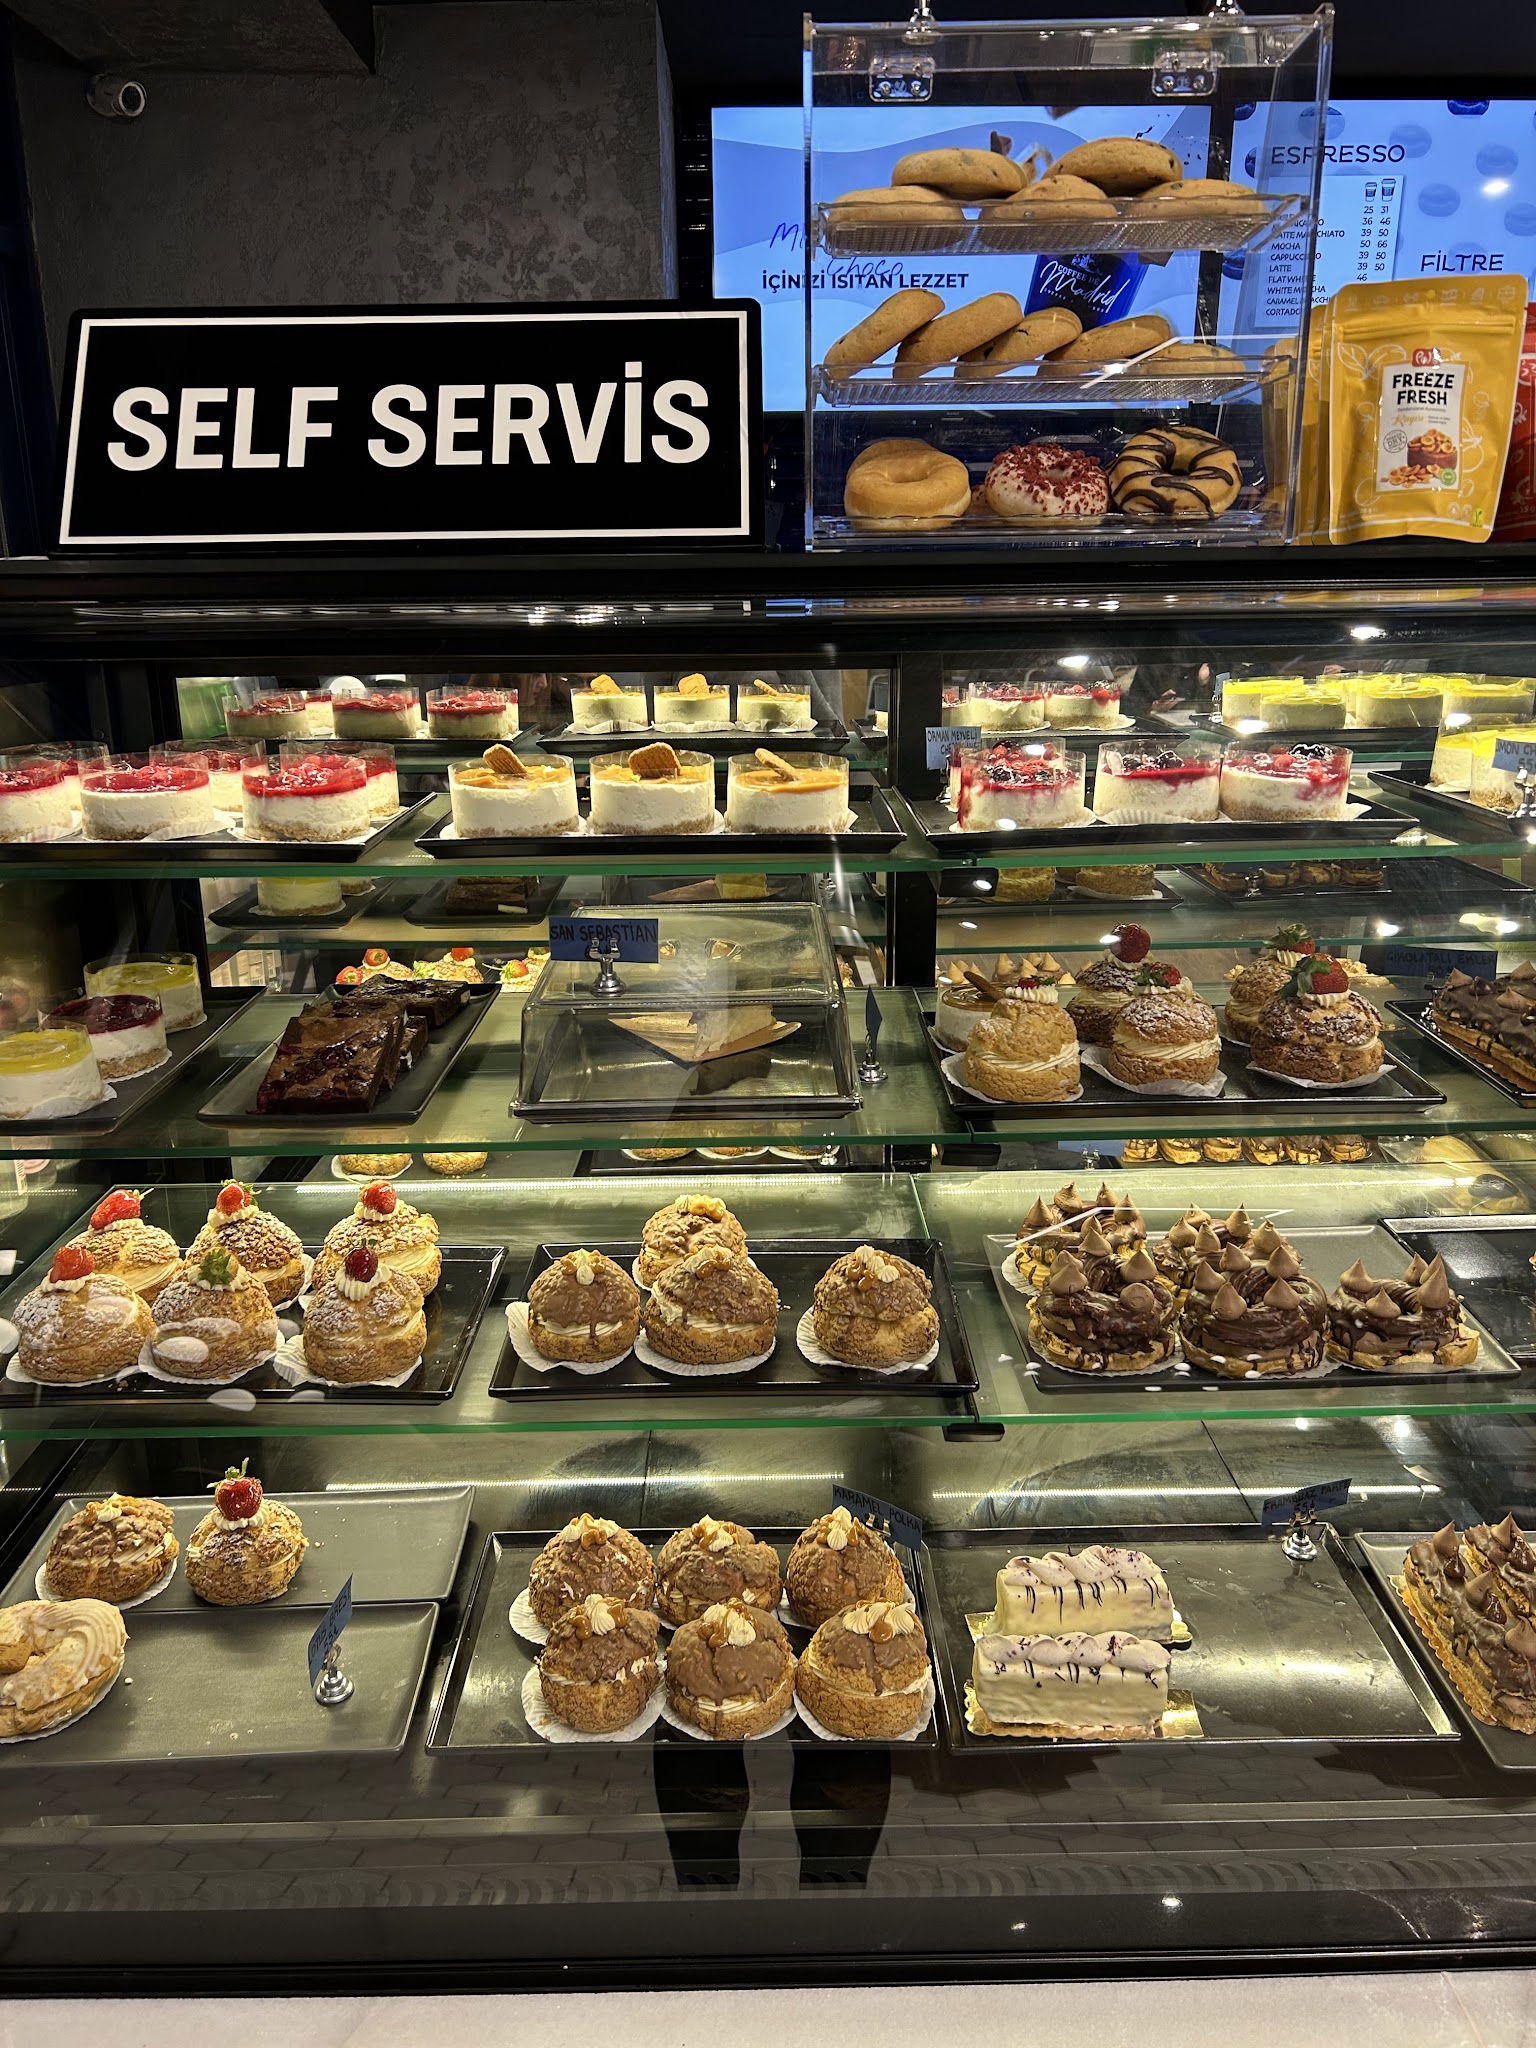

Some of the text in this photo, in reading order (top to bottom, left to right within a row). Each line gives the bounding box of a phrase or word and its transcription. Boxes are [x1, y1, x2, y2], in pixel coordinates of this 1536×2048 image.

[1363, 205, 1389, 214] 25 31
[1362, 217, 1391, 225] 36 46
[1274, 228, 1389, 239] ATTE MACHIATO 39 50
[1271, 240, 1388, 250] MOCHA 50 66
[1270, 251, 1386, 261] CAPPUCCO 39 50
[1421, 250, 1504, 271] FİLTRE
[1269, 262, 1385, 272] LATTE 39 50
[762, 269, 969, 293] İÇİNZİ ISITAN LEZZET
[1268, 275, 1287, 283] FLAT
[1356, 273, 1368, 282] 46
[1040, 260, 1131, 314] Madrid
[1267, 285, 1326, 295] WHITE MCHA
[1266, 297, 1299, 305] CARAMEL
[1392, 373, 1455, 389] FREEZE
[1397, 390, 1447, 405] FRESH
[107, 361, 711, 471] SELF SERVİS
[550, 924, 575, 941] SAN
[834, 1486, 885, 1516] KARAMEL
